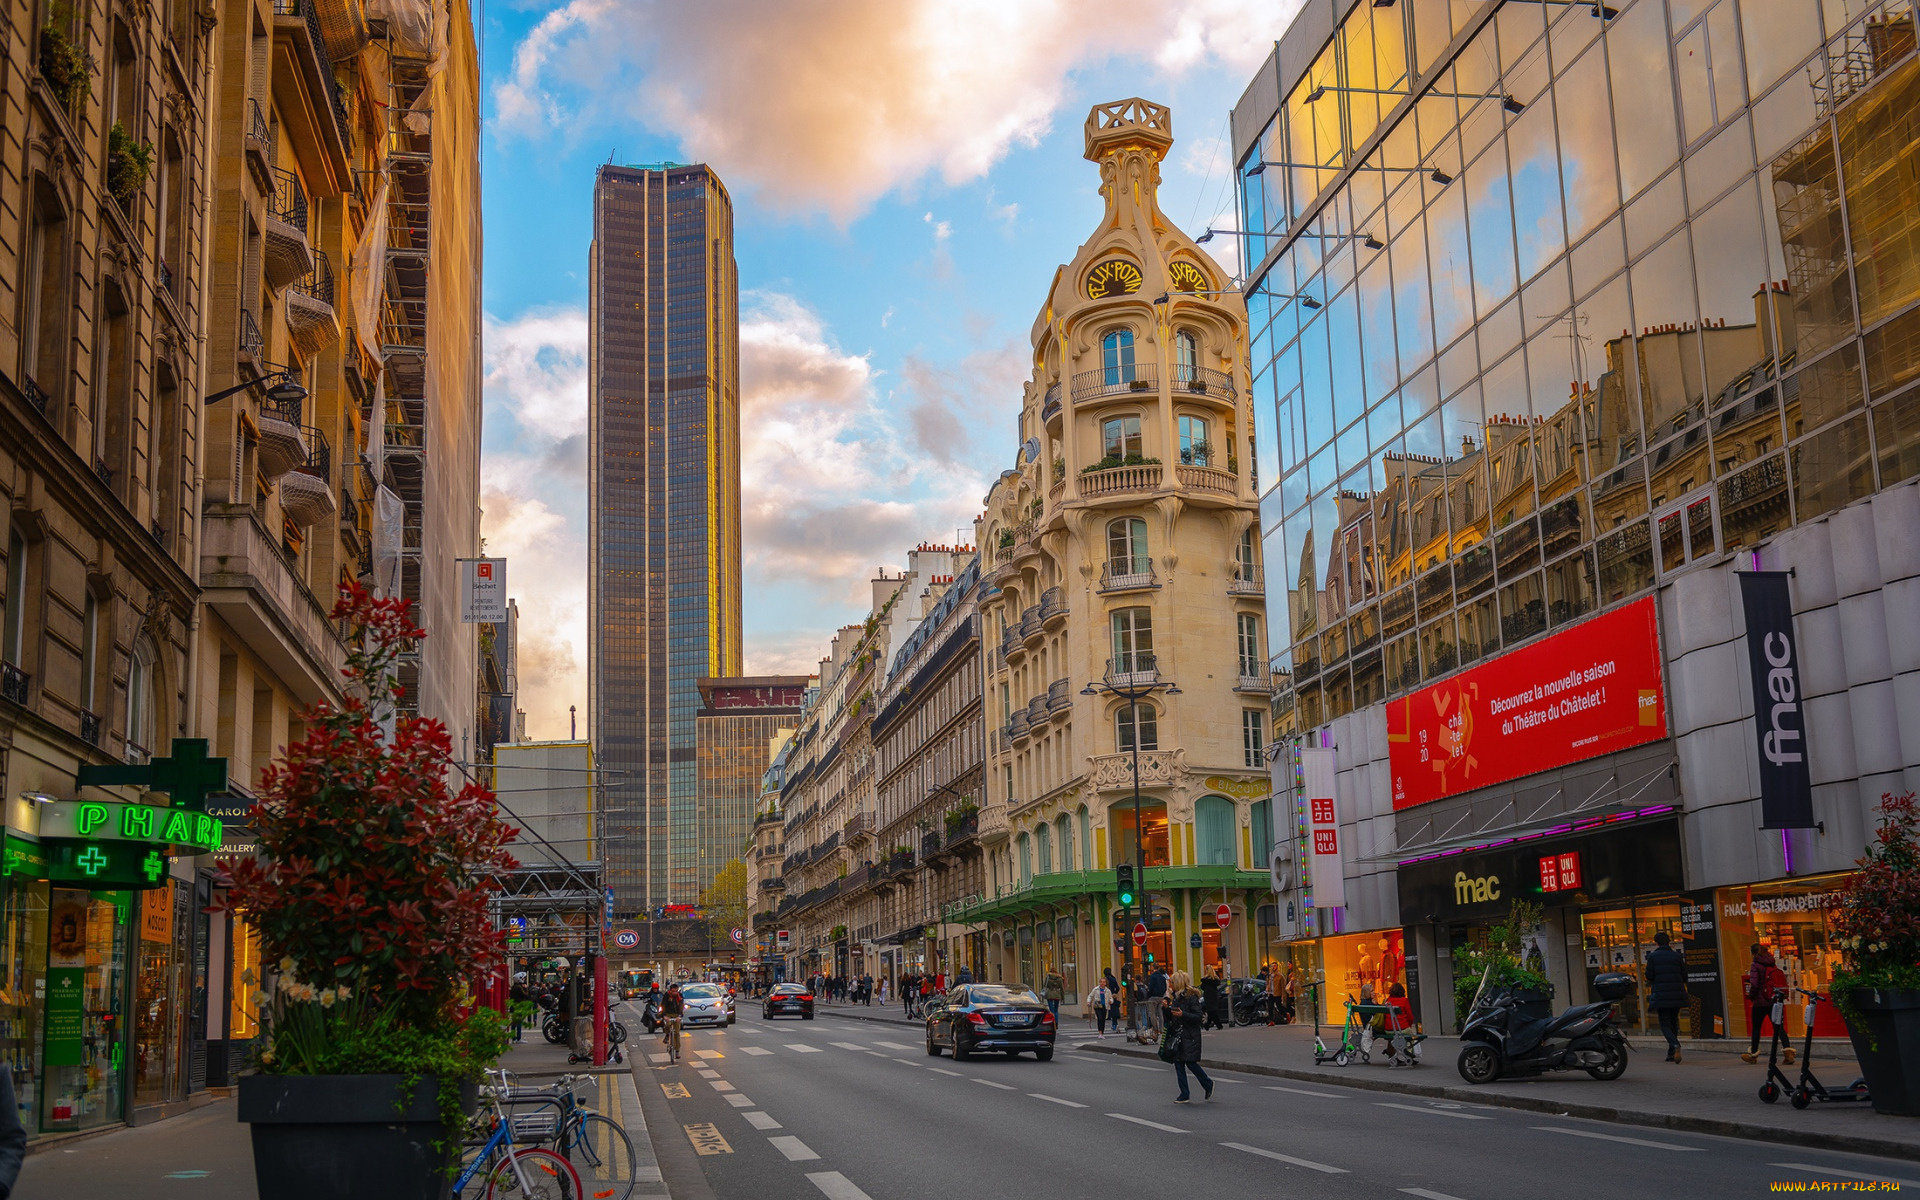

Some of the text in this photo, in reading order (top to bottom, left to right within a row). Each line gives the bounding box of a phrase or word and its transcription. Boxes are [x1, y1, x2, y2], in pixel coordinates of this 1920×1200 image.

[1490, 660, 1615, 716] Découvrez la nouvelle saison
[1637, 694, 1658, 709] fnac
[1763, 631, 1802, 767] fnac
[1502, 719, 1513, 735] du
[1513, 708, 1547, 732] Théâtre
[1547, 702, 1559, 720] du
[1560, 689, 1601, 718] Châtelet
[1448, 711, 1463, 729] châ
[1418, 729, 1428, 744] 19
[1420, 746, 1429, 763] 20
[1451, 745, 1464, 759] let
[1395, 790, 1405, 801] PARIS
[208, 807, 253, 817] CAROL
[1316, 832, 1333, 842] UNI
[1317, 842, 1335, 852] QLO
[1560, 857, 1574, 871] UNI
[1562, 871, 1576, 887] QLO
[1454, 871, 1500, 905] fnac
[1724, 902, 1749, 918] FNAC,
[1751, 899, 1775, 915] C'EST
[1776, 897, 1797, 913] BON
[618, 934, 636, 944] C&A
